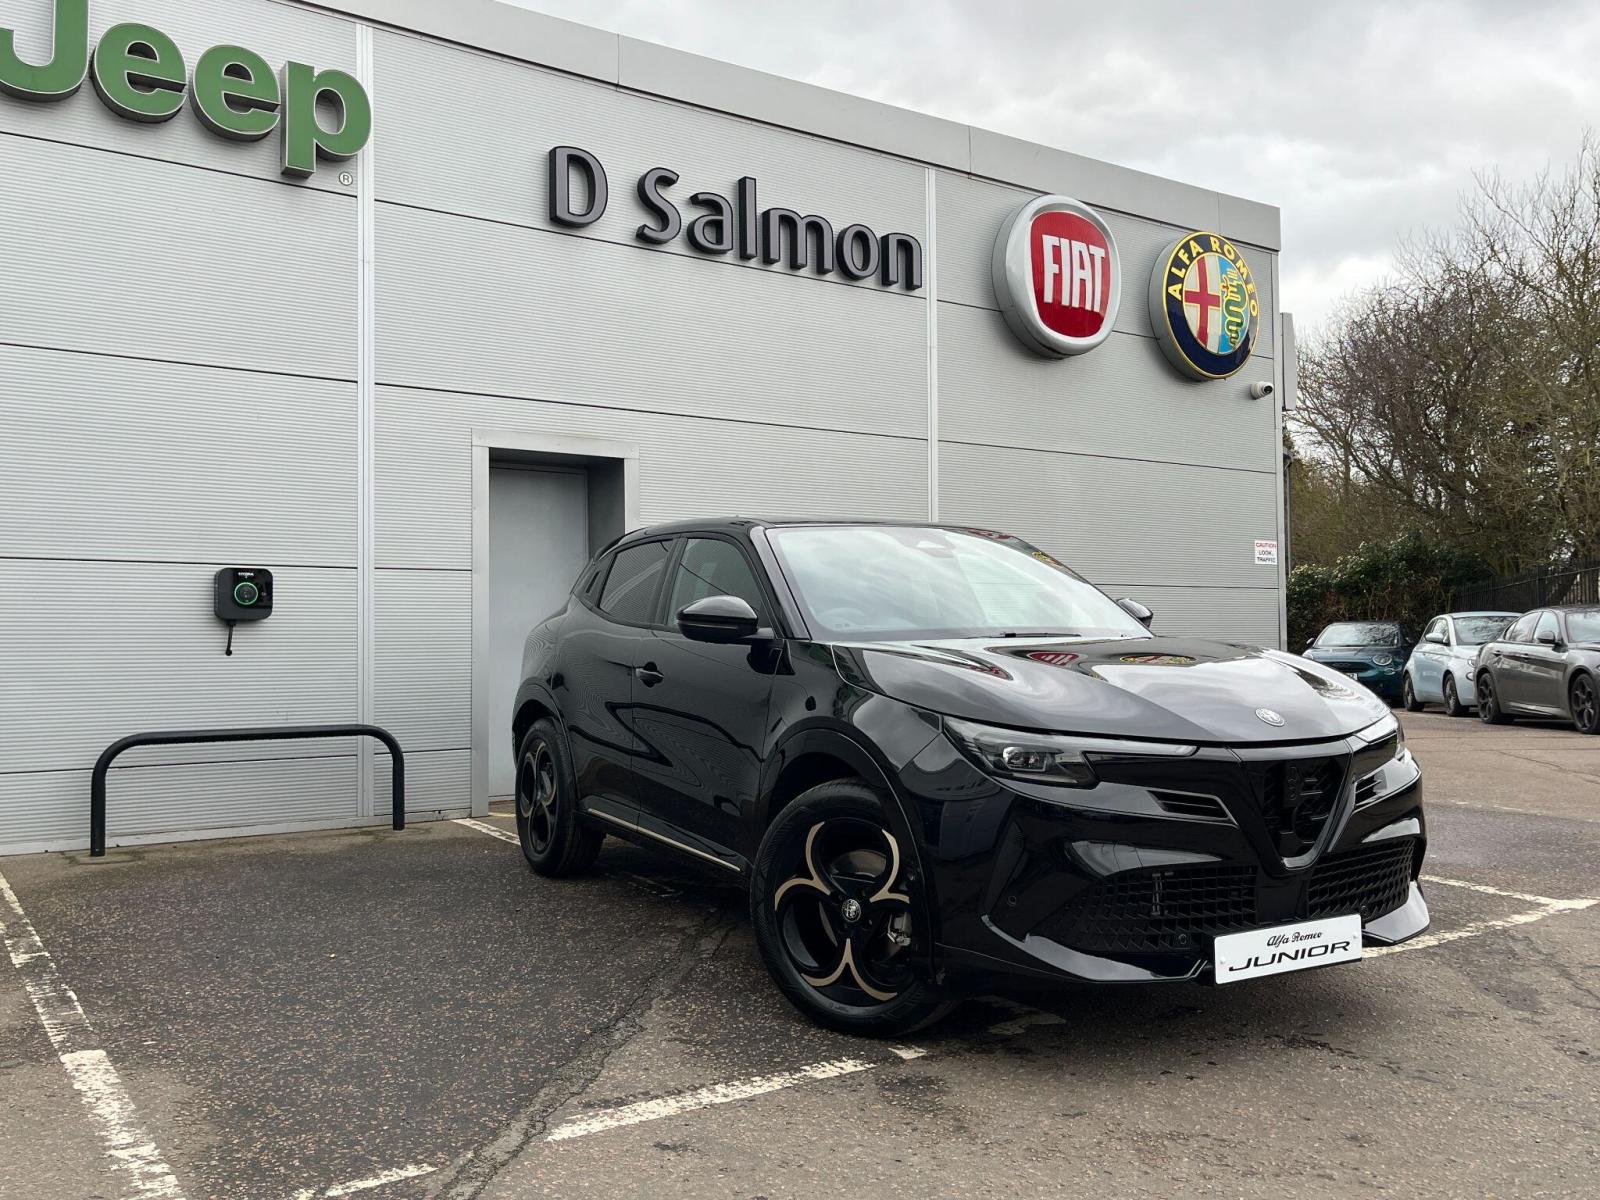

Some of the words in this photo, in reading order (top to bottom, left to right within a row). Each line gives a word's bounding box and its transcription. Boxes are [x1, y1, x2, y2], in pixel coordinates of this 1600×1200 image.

[0, 0, 372, 177] Jeep
[549, 145, 608, 228] D
[636, 167, 923, 290] Salmon
[1042, 234, 1105, 313] FIAT
[1168, 240, 1204, 301] ALFA
[1209, 236, 1259, 317] ROMEO
[1228, 940, 1351, 972] JUNIOR
[1267, 935, 1290, 948] Alfa
[1291, 931, 1323, 943] Romeo
